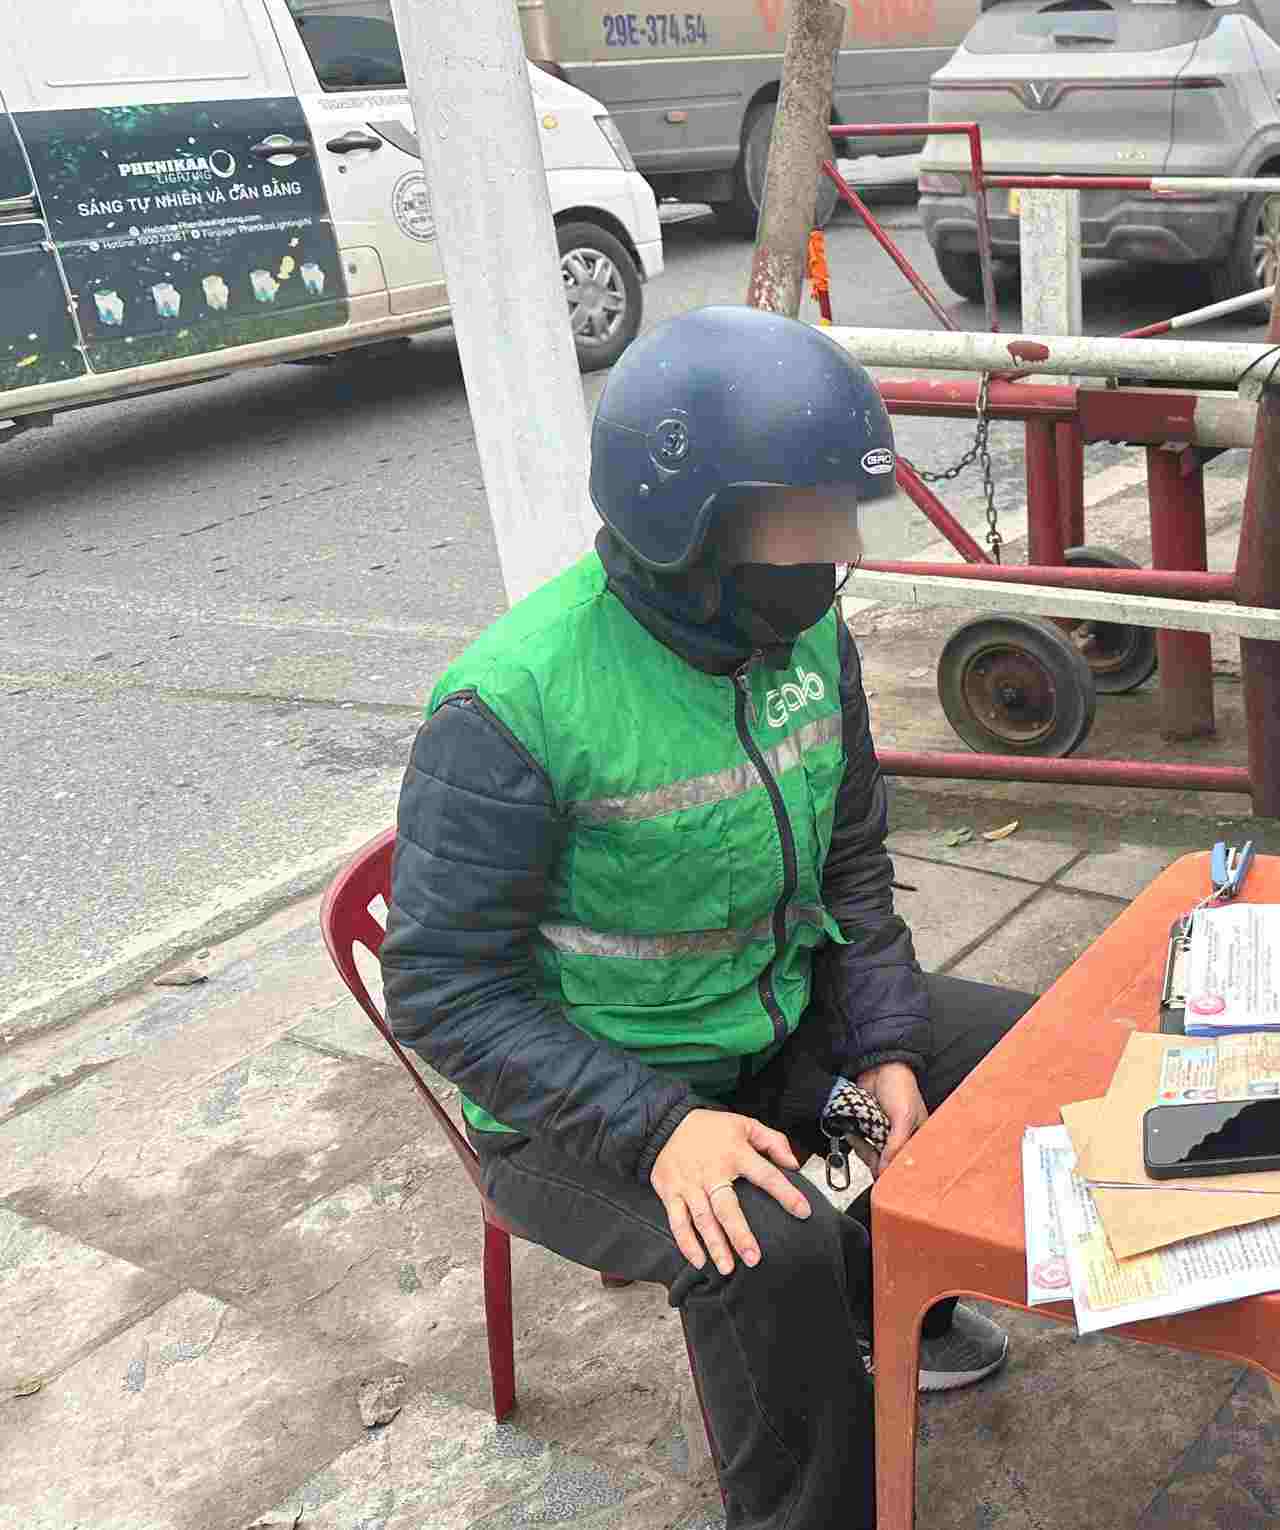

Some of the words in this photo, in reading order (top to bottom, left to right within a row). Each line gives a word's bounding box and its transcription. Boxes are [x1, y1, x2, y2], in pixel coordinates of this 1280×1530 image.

[602, 13, 707, 46] 29E-374.54
[117, 158, 210, 177] PHENIKAA
[77, 198, 124, 217] SÁNG
[127, 196, 151, 215] TỰ
[155, 189, 203, 209] NHIÊN
[206, 186, 227, 203] VÀ
[262, 177, 302, 197] BẰNG
